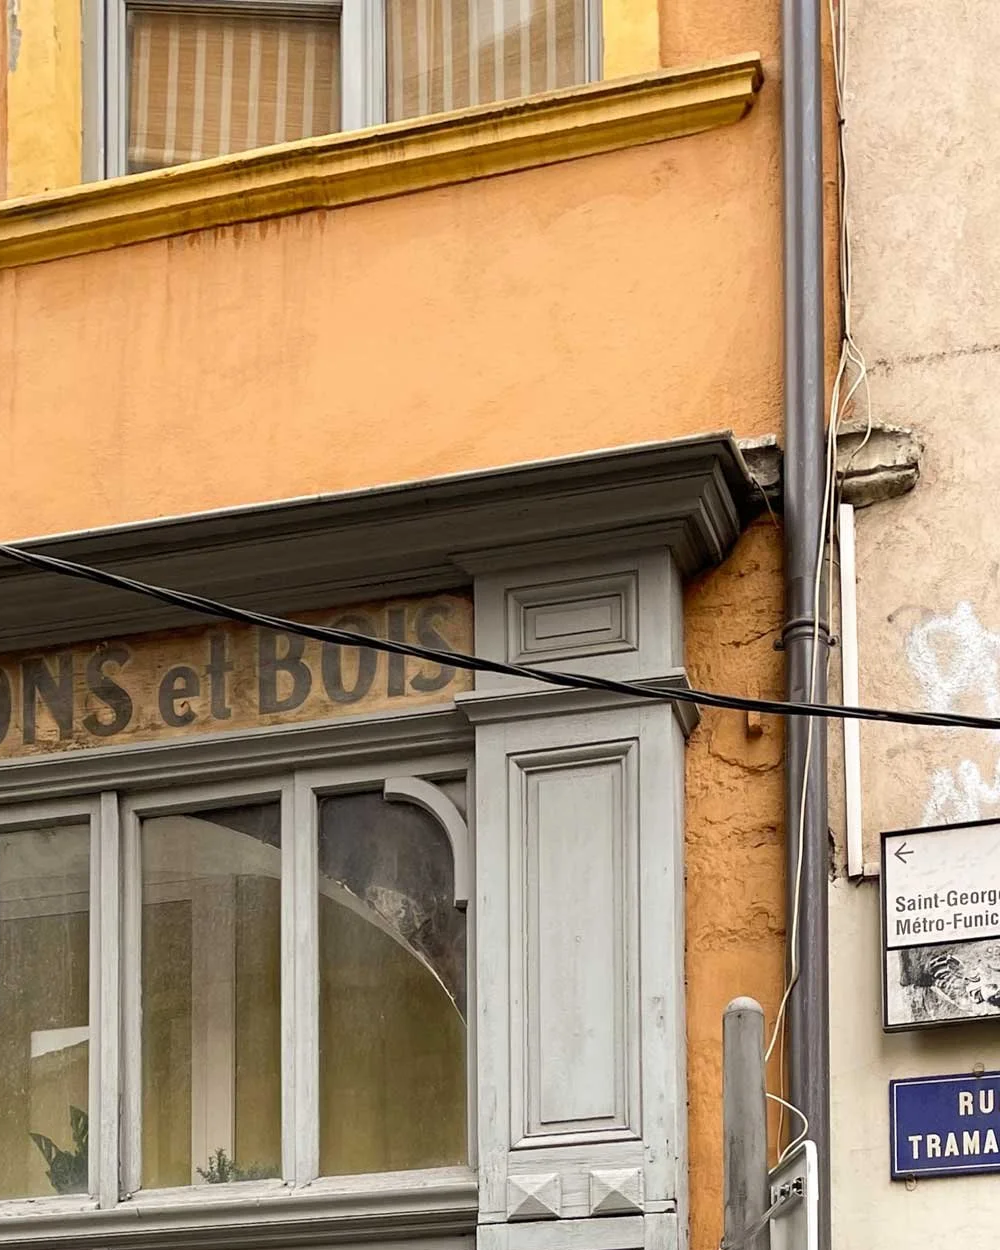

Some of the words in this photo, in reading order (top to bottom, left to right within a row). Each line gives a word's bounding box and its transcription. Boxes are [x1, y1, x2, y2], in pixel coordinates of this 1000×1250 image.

[158, 632, 232, 728] et
[256, 602, 457, 716] BOIS
[895, 889, 1000, 912] Saint-Georg
[896, 910, 999, 935] Métro-Funic
[959, 1089, 1000, 1116] RU
[908, 1129, 999, 1159] TRAMA
